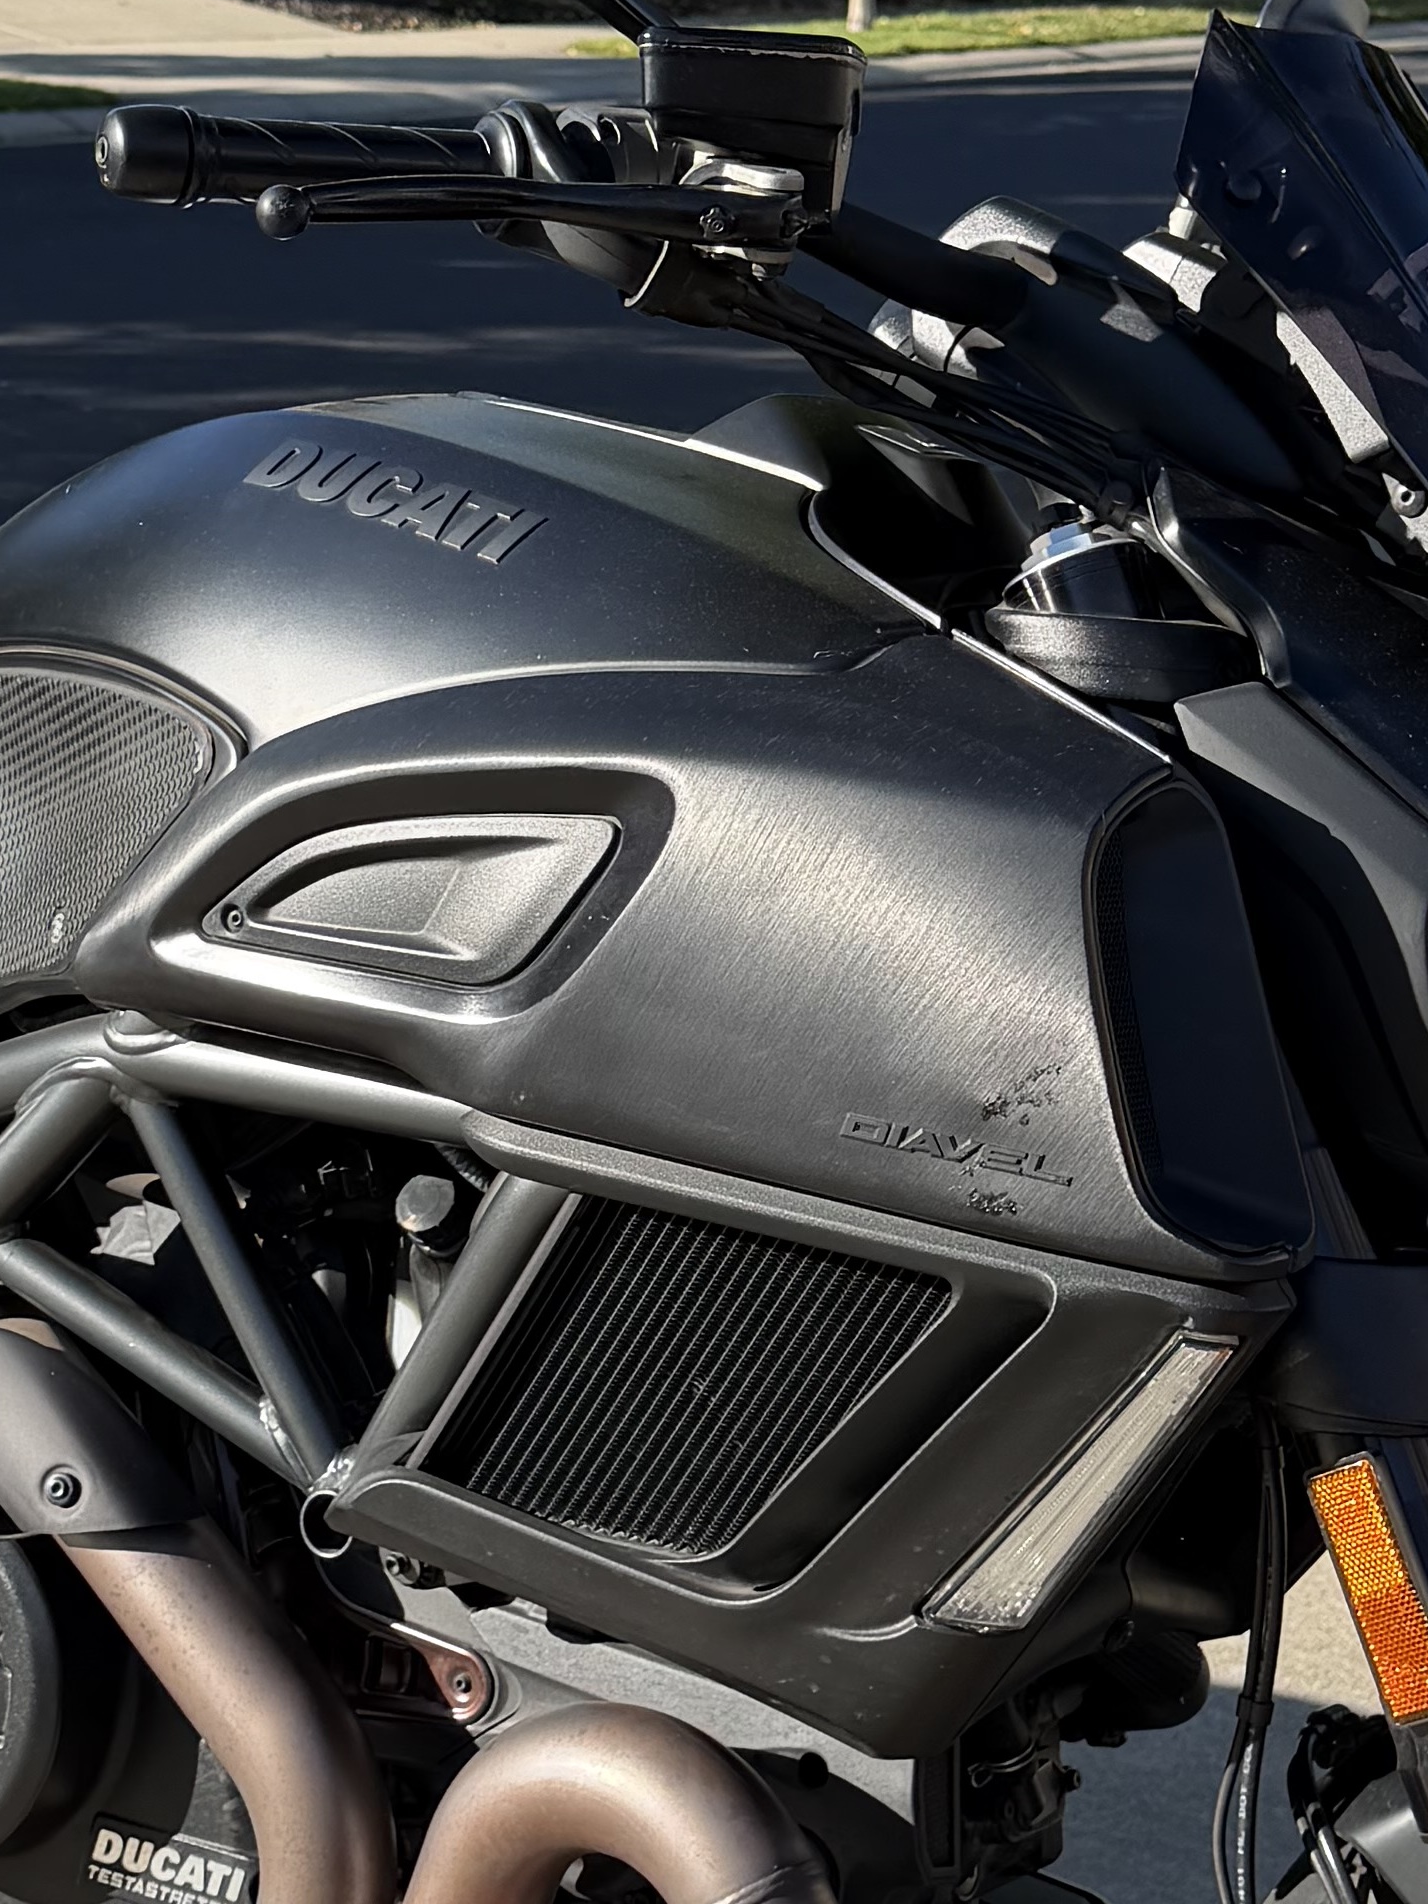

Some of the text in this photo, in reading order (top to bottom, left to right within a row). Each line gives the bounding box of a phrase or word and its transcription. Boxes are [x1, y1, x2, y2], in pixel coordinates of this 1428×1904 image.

[243, 438, 549, 565] DUCATI
[839, 1112, 1073, 1186] DIAVEL
[91, 1828, 246, 1903] DUCATI
